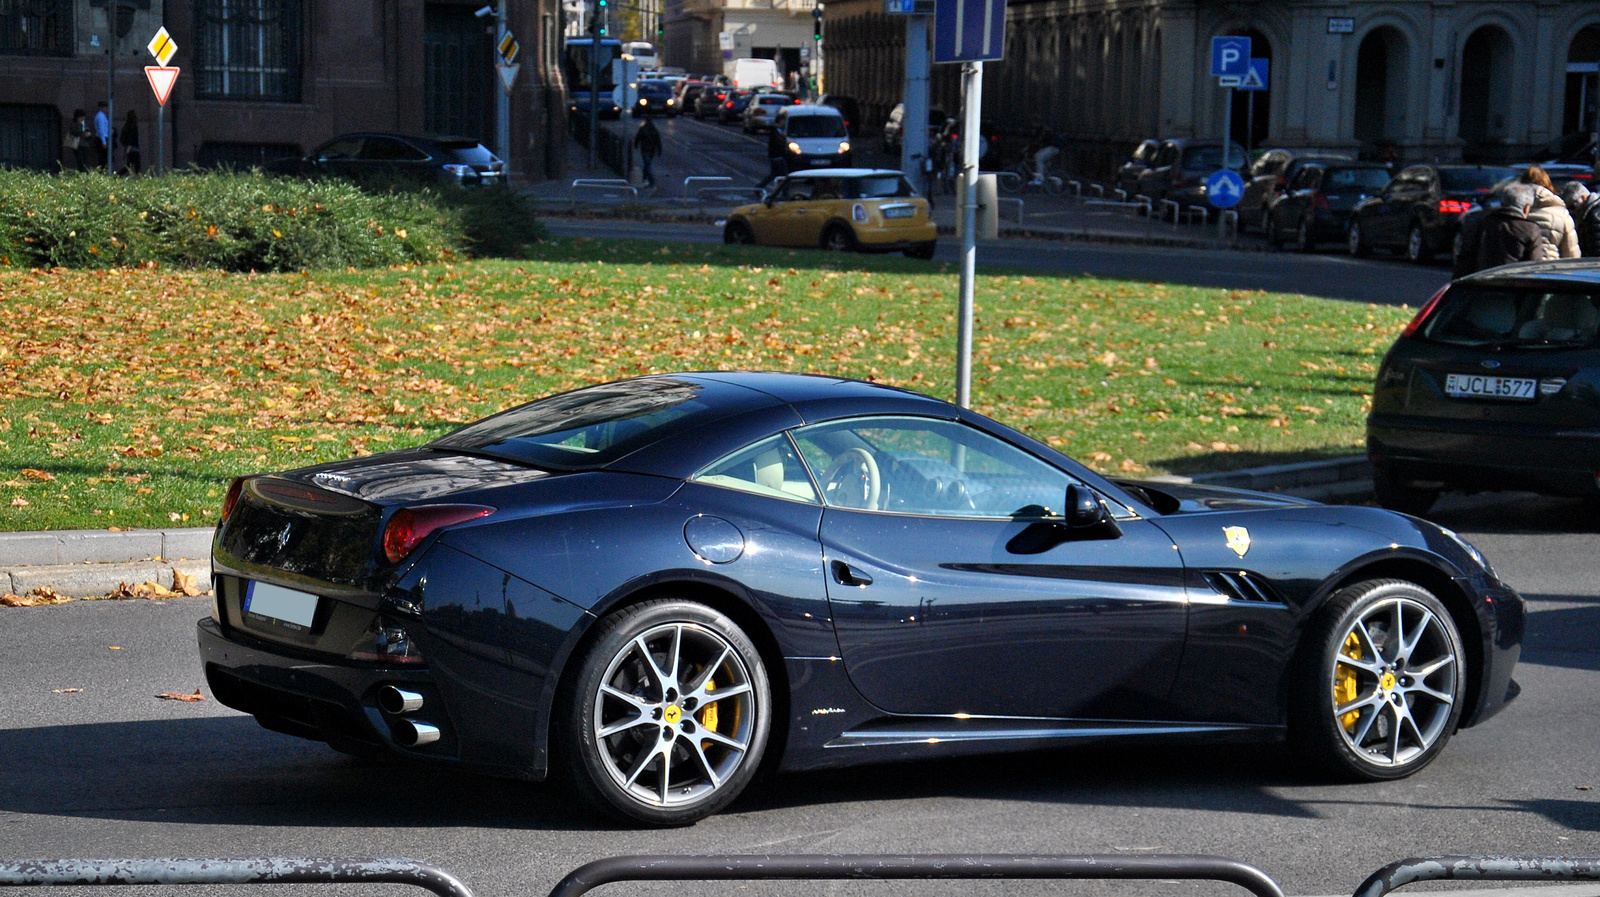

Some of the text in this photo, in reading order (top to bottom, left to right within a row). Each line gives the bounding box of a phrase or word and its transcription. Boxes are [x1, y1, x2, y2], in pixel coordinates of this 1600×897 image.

[1222, 49, 1239, 71] P
[1460, 378, 1533, 396] JCL 577
